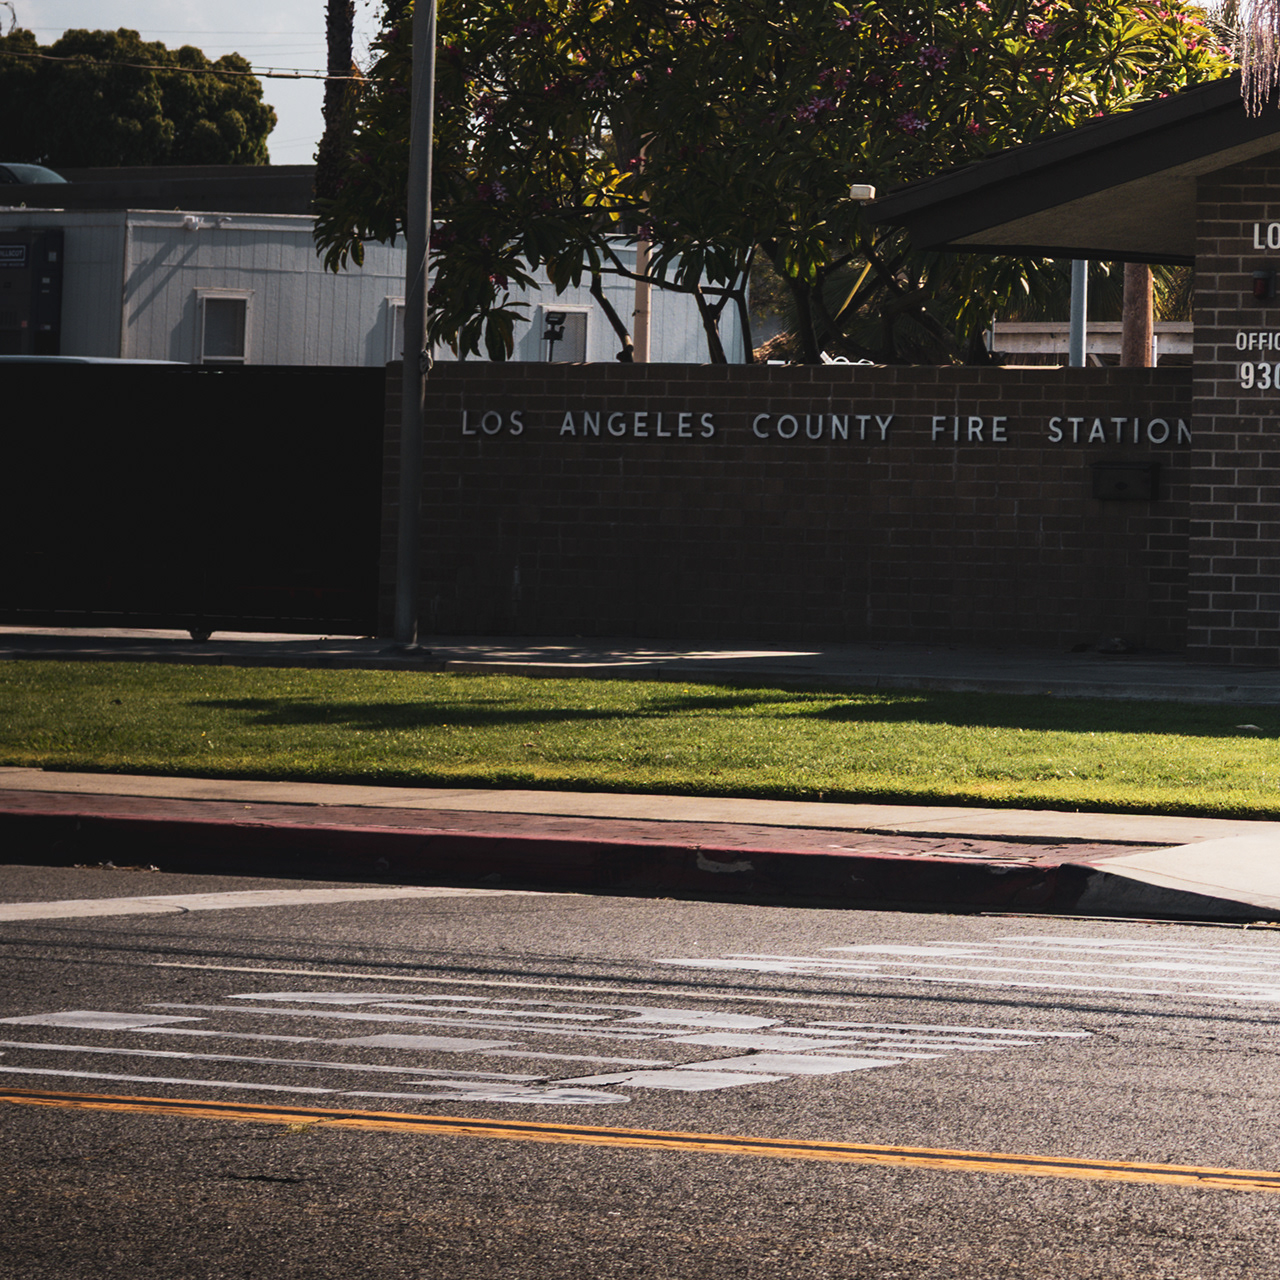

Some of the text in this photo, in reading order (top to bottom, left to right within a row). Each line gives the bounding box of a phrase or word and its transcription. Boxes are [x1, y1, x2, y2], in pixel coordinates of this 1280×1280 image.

[462, 410, 1191, 445] LOS ANGELES COUNTY FIRE STATION
